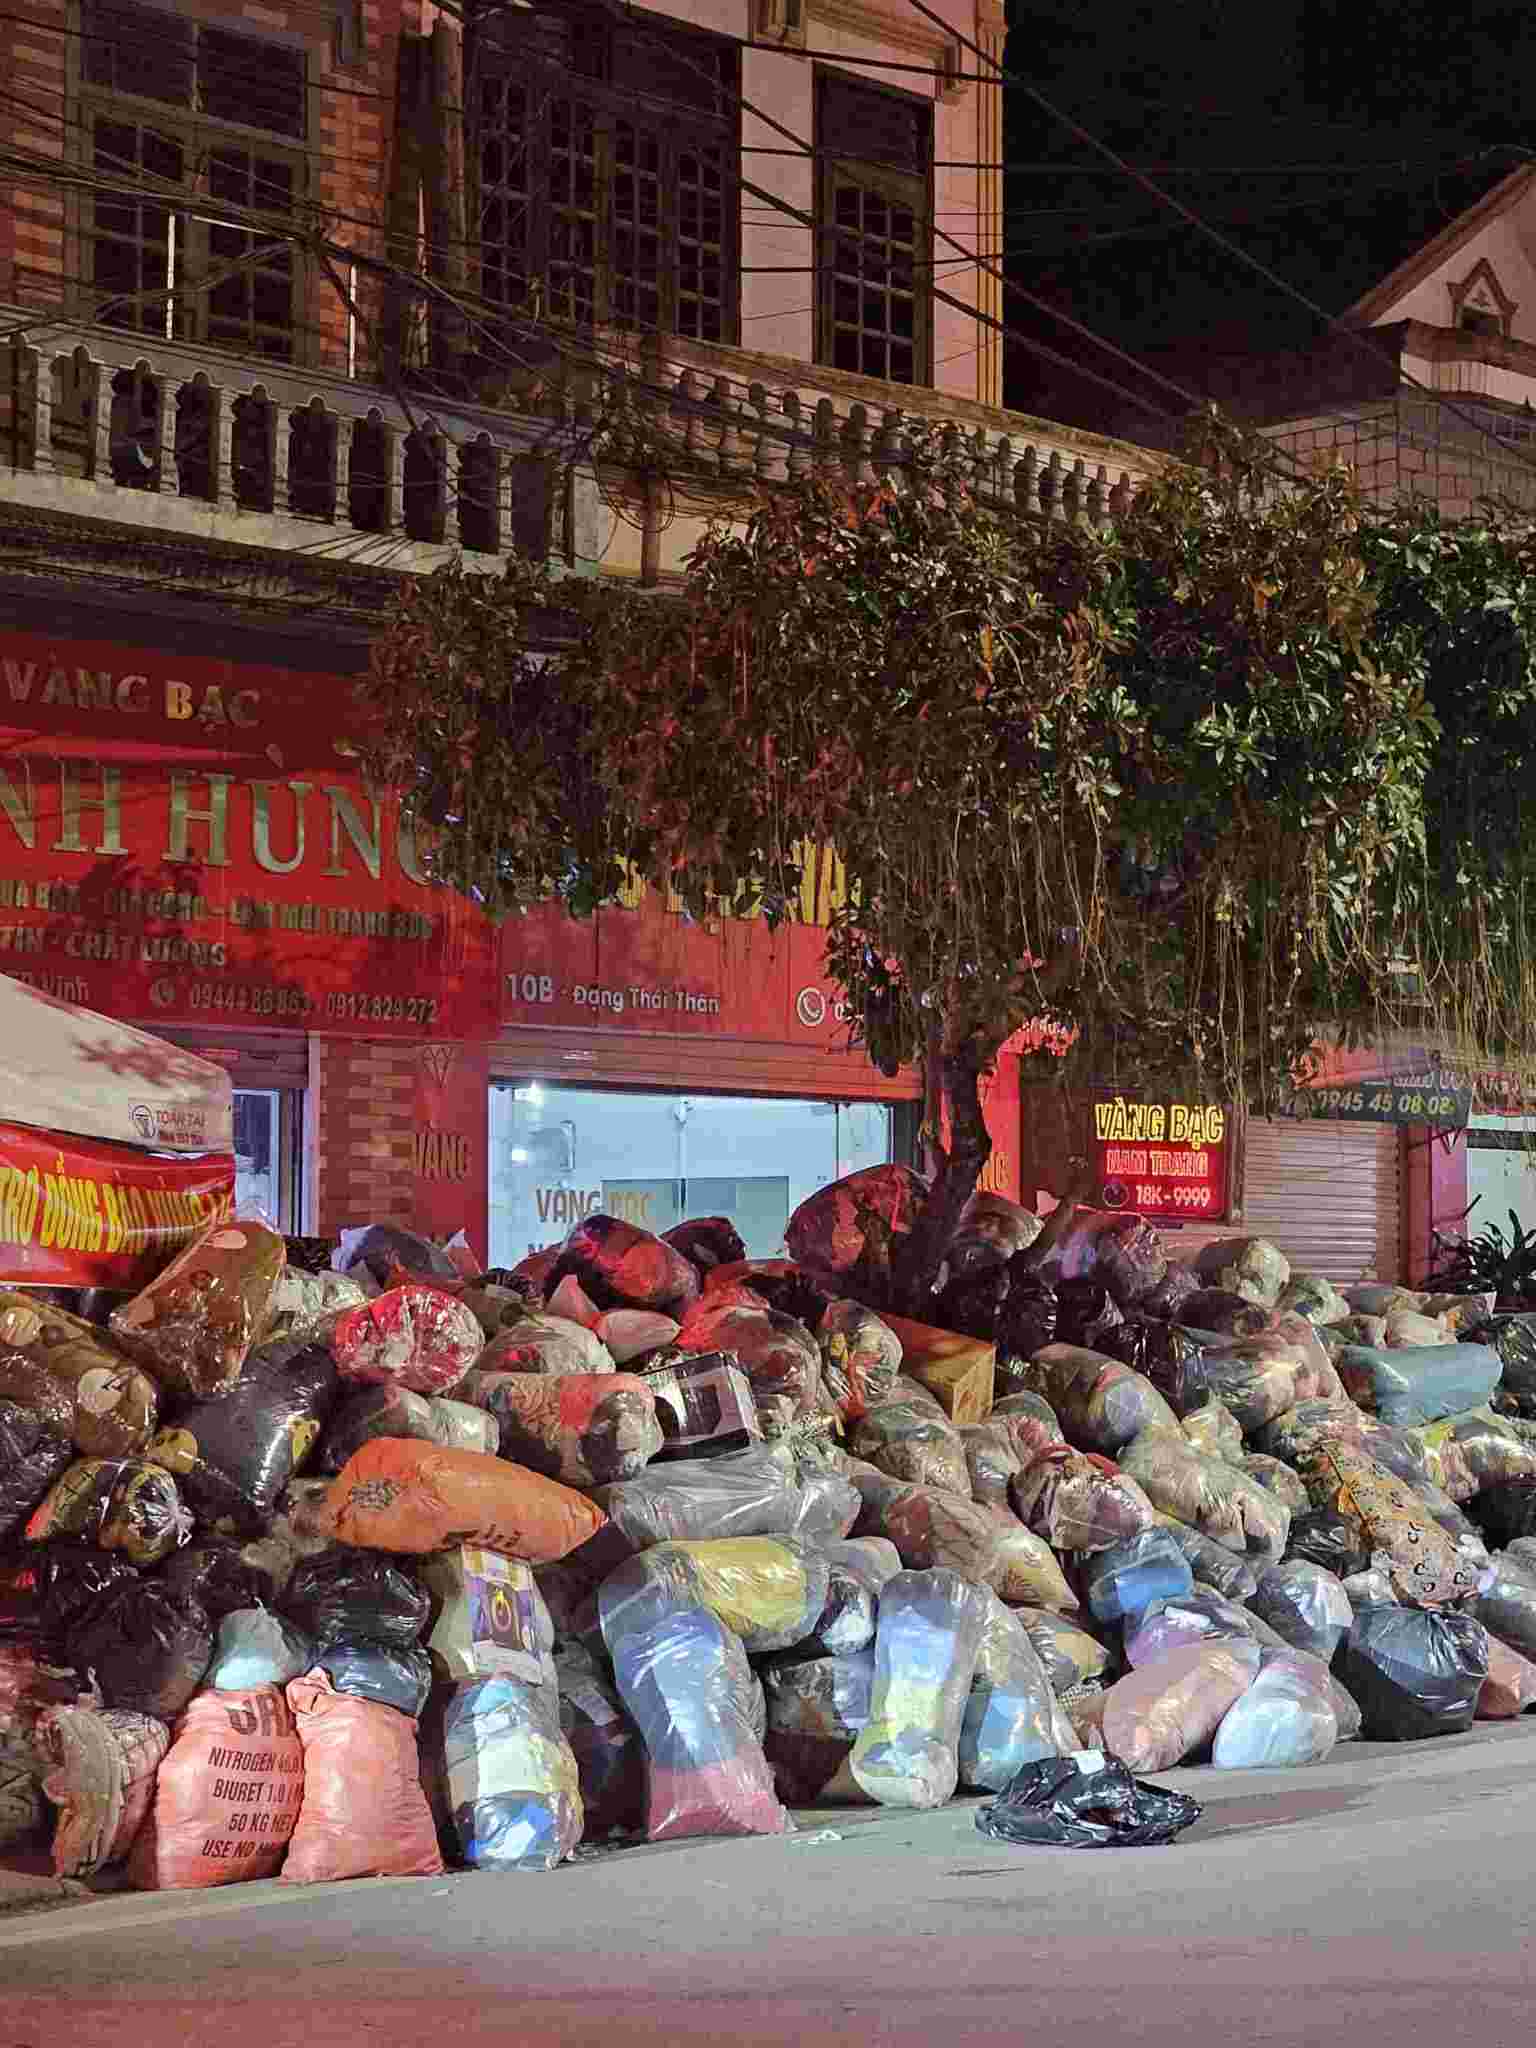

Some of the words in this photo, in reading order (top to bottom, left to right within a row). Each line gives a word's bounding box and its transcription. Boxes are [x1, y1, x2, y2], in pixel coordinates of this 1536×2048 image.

[1, 654, 148, 712] VÀNG
[165, 679, 261, 733] BẠC
[504, 974, 553, 1002] 10B
[1095, 1096, 1166, 1142] VÀNG
[1169, 1103, 1224, 1150] BẠC
[208, 1747, 274, 1772] NITROGEN
[213, 1778, 265, 1803] BIURET
[228, 1813, 248, 1833] 50
[250, 1813, 270, 1833] KG
[202, 1839, 233, 1858] USE
